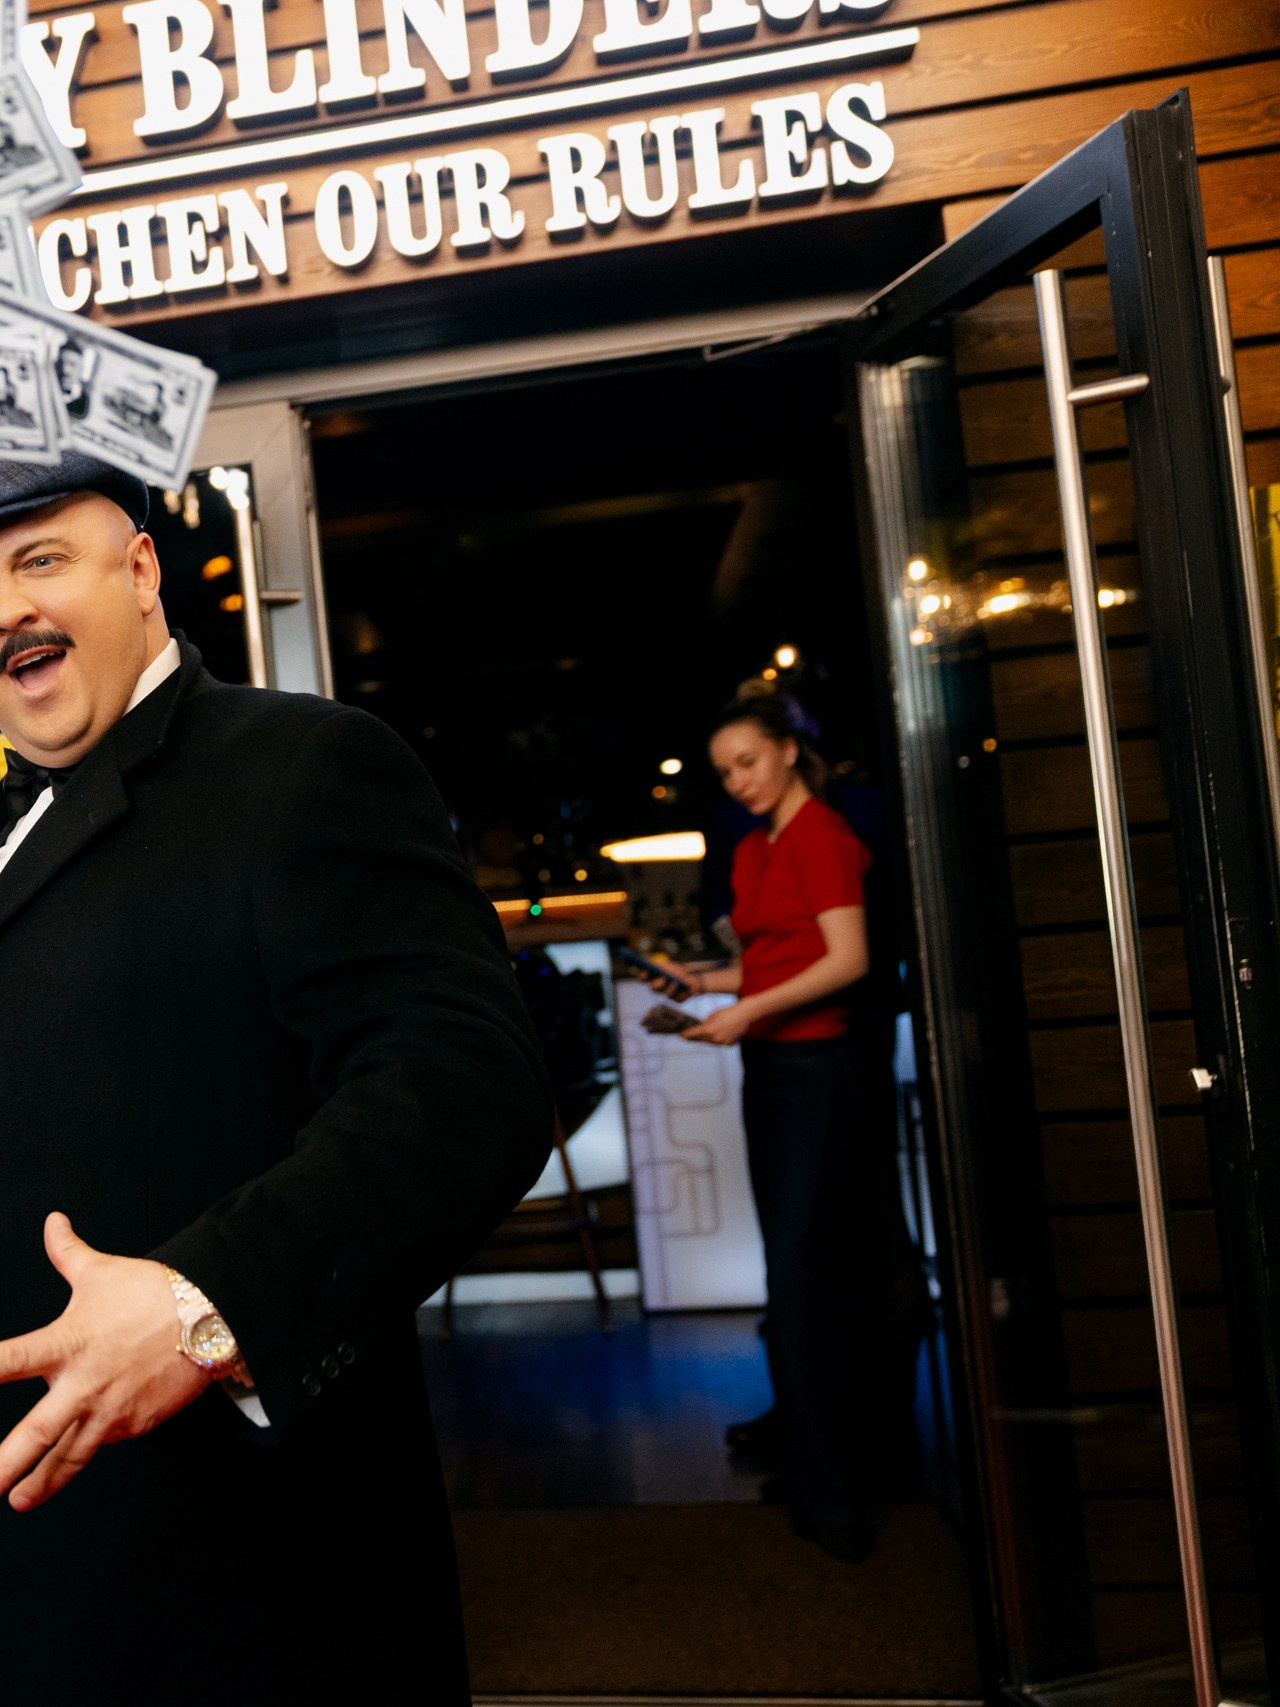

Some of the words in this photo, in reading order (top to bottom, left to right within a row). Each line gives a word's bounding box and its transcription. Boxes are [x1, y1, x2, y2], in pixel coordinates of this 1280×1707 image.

[36, 181, 288, 313] CHEN
[315, 148, 525, 267] OUR
[537, 81, 896, 233] RULES
